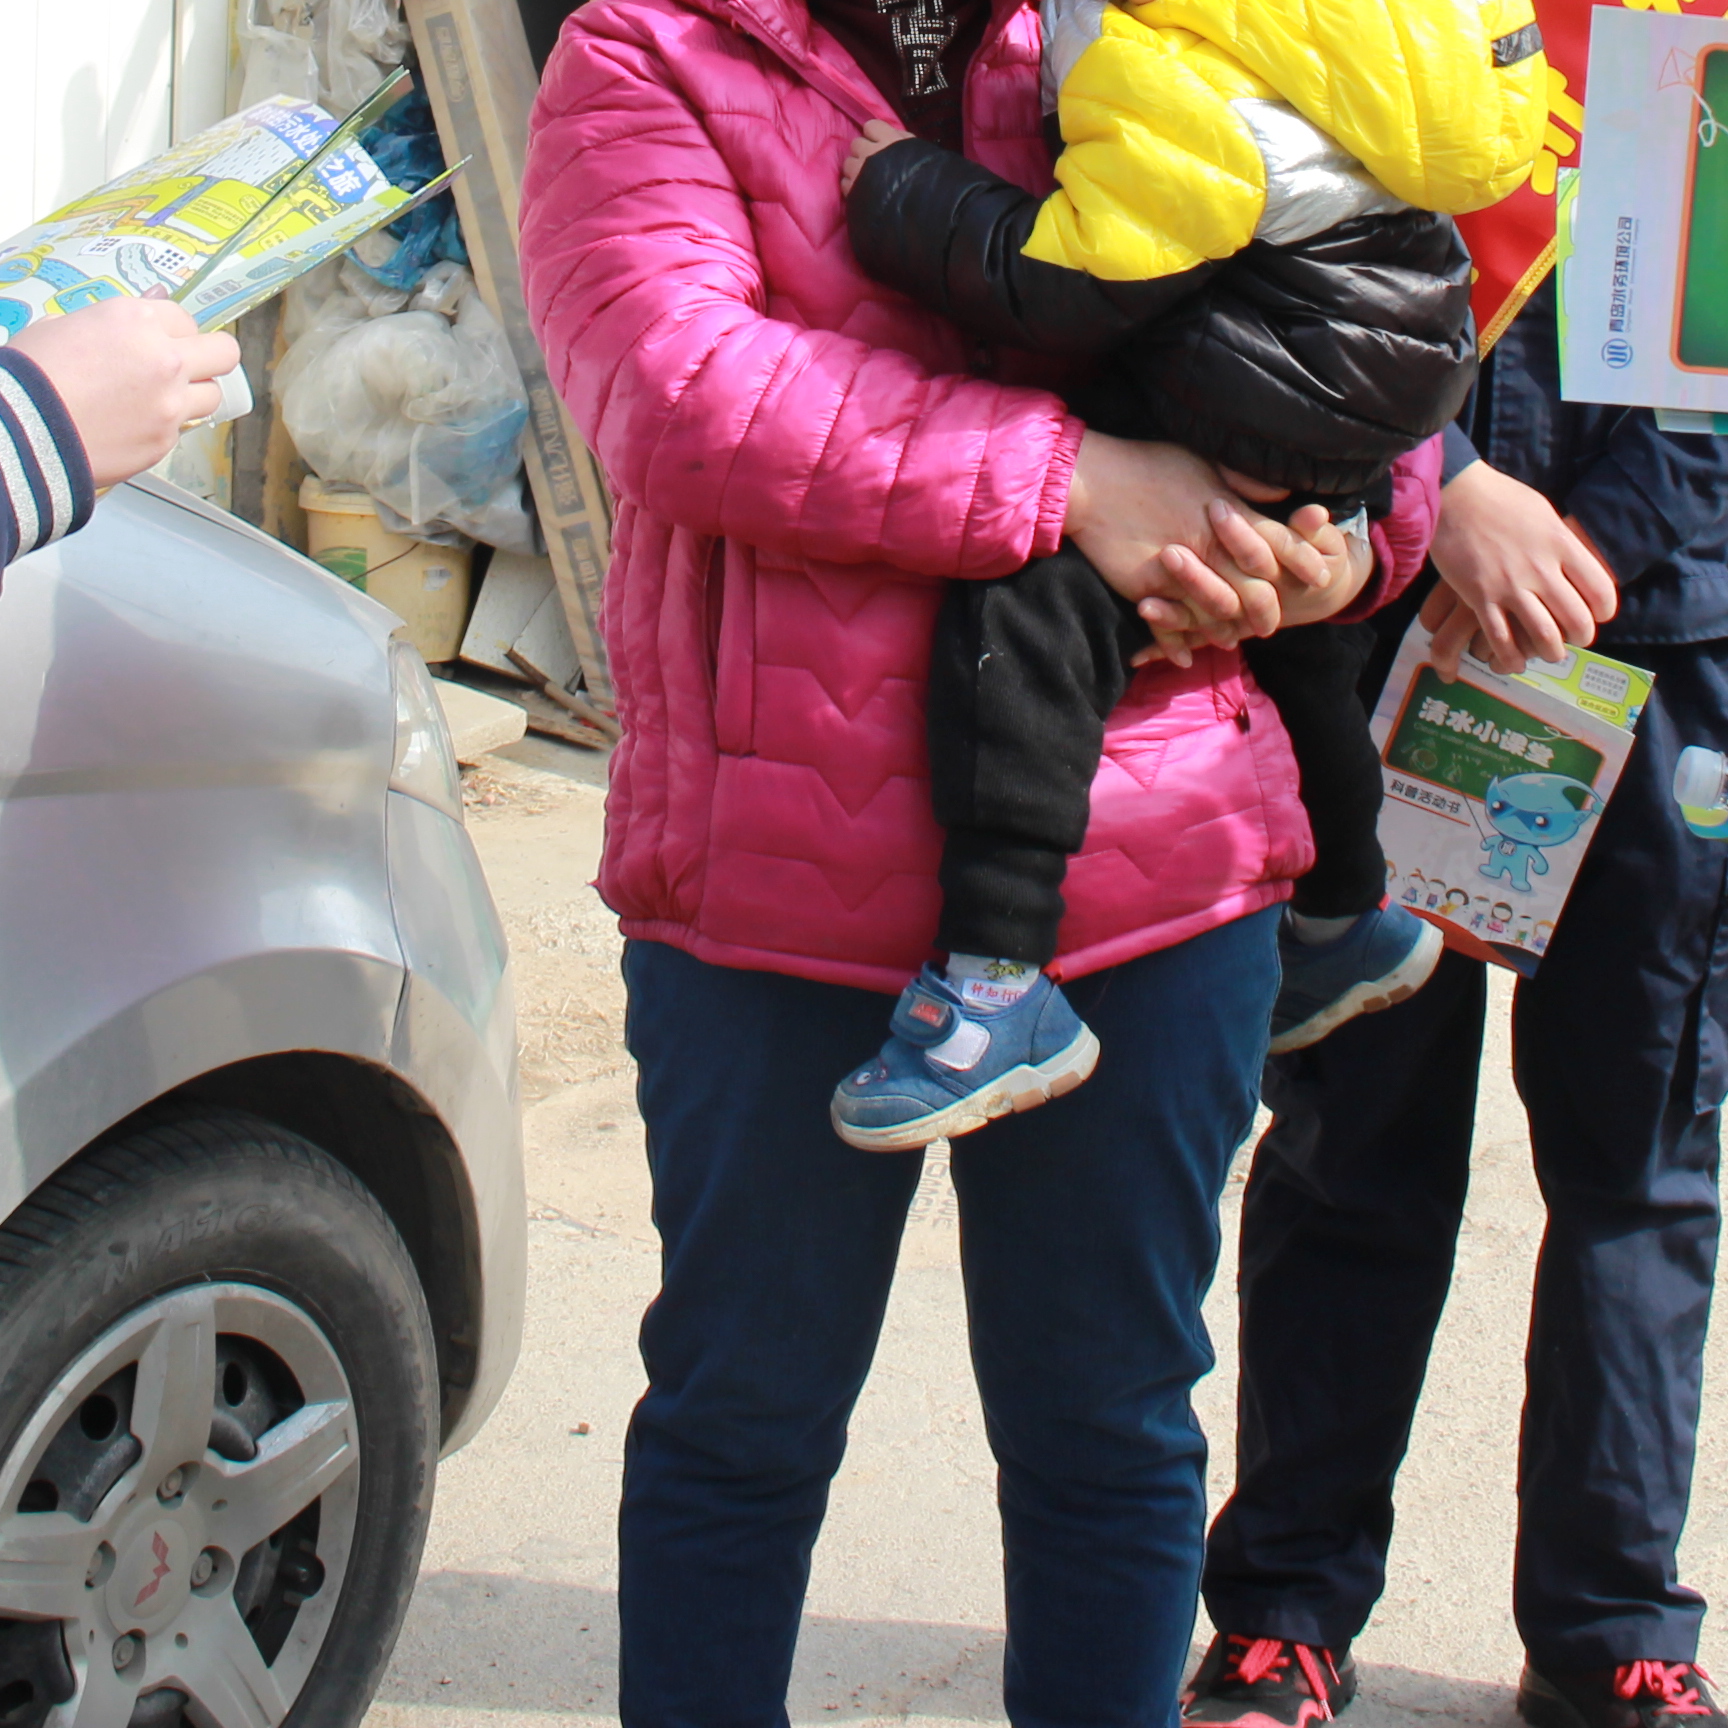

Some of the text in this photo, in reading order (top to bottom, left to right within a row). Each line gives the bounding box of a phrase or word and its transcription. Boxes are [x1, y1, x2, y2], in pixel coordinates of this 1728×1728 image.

[1608, 216, 1633, 333] 青岛水务环境公司
[1418, 695, 1555, 768] 清水小课堂
[1390, 777, 1462, 815] 科普活动书
